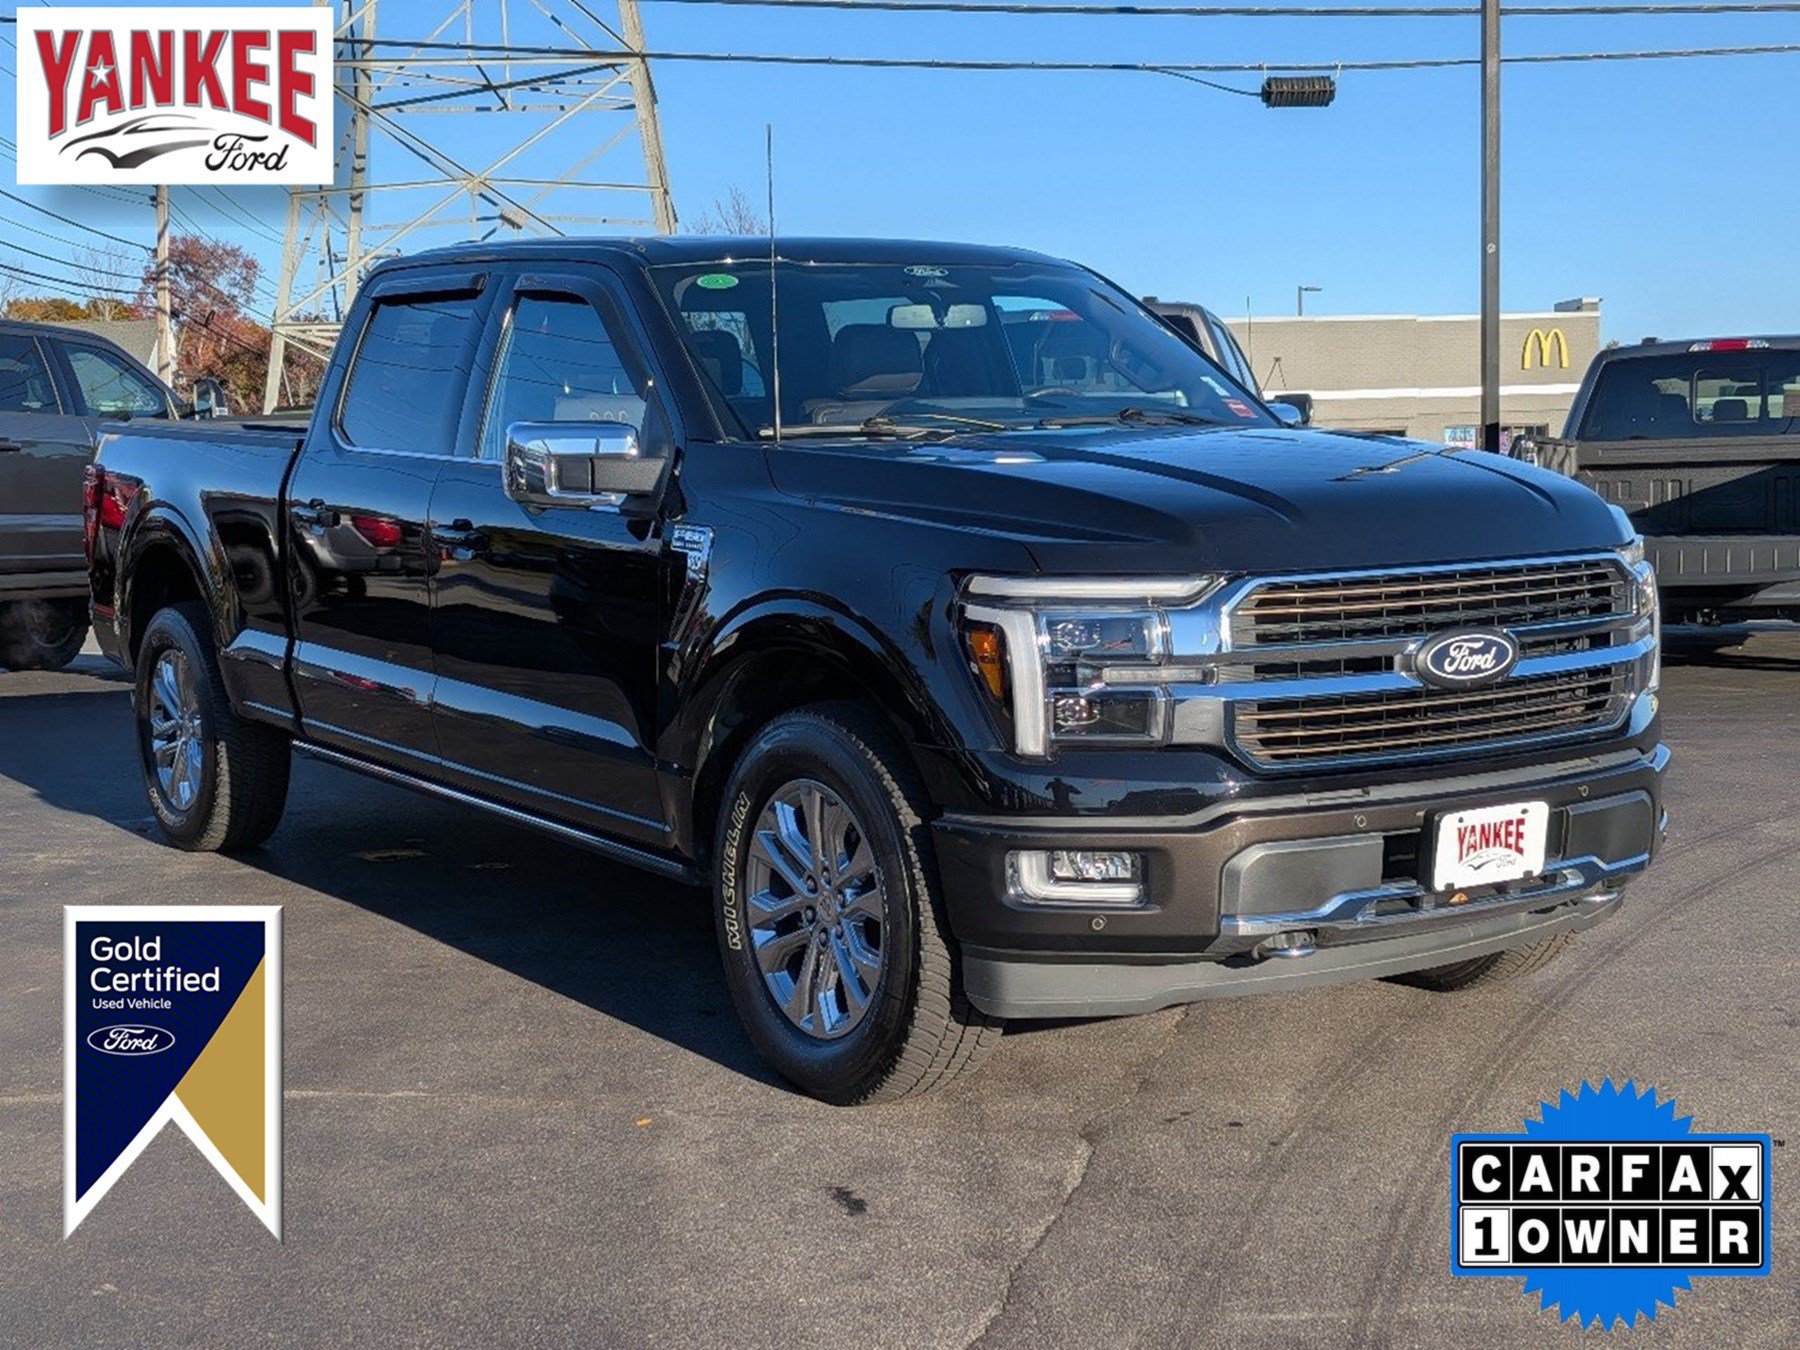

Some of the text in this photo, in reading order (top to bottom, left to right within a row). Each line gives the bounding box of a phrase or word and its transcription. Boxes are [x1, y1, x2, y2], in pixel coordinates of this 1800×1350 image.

[1444, 641, 1497, 673] Ford
[1457, 818, 1525, 864] YANKEE
[722, 791, 751, 950] MICHELIN
